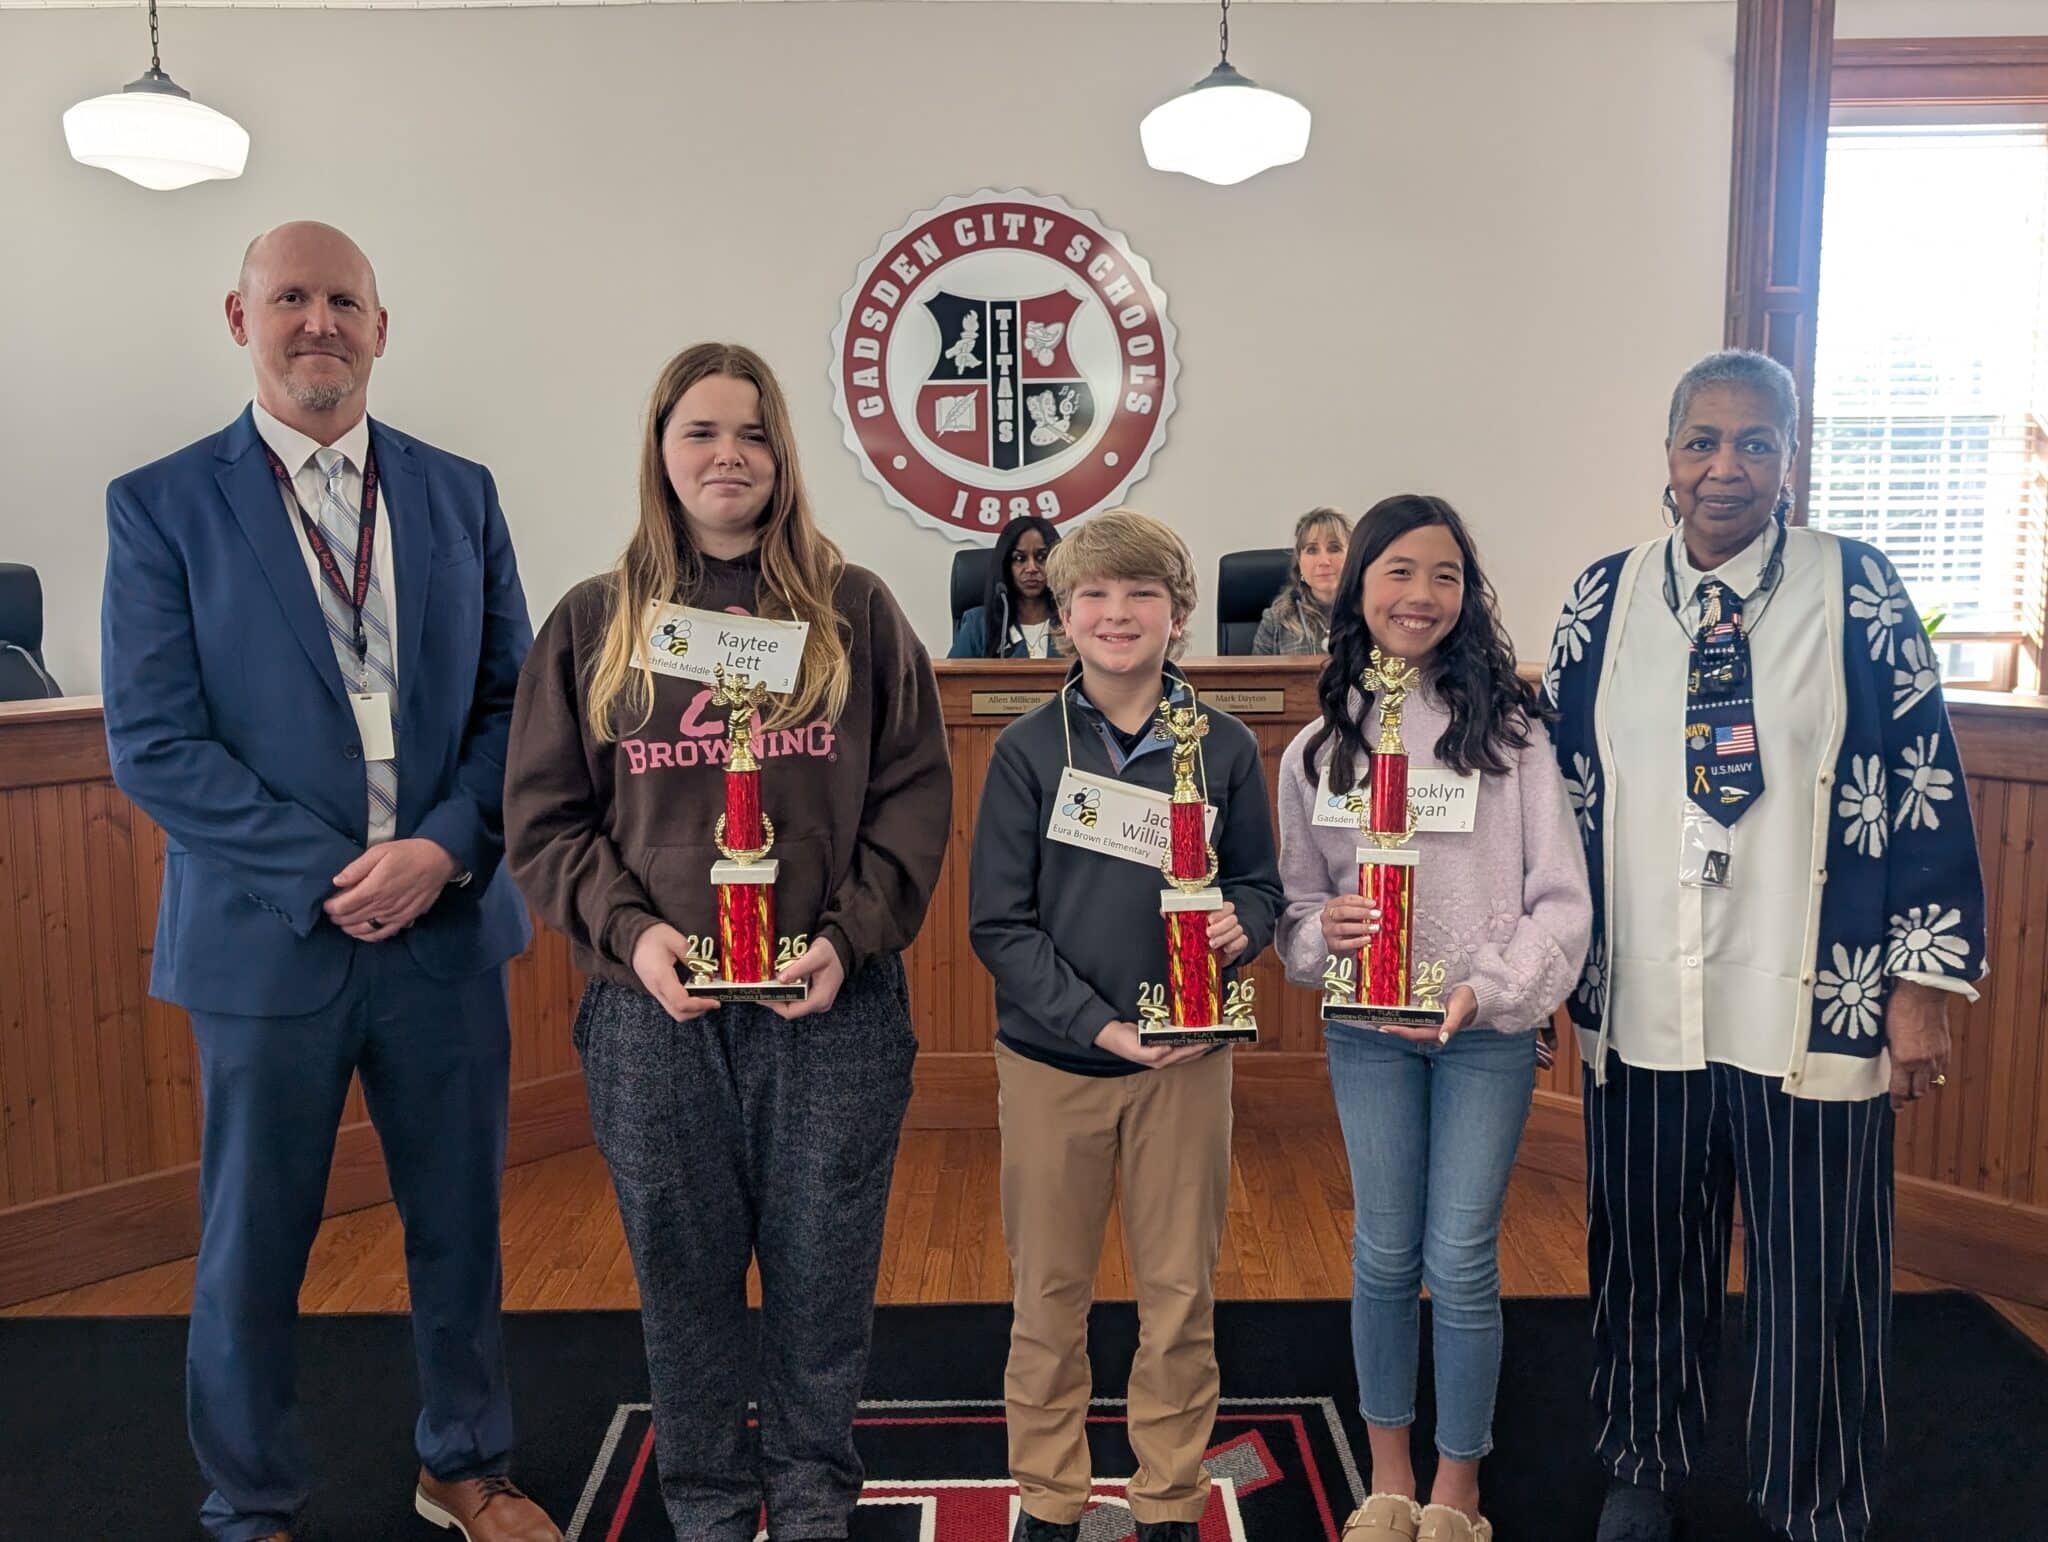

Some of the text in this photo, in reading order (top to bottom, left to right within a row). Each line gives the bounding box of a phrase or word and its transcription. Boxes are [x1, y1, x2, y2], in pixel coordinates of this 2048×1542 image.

[853, 212, 1157, 418] GADSDEN CITY SCHOOLS
[995, 308, 1014, 443] TITANS
[951, 490, 1060, 525] 1889
[717, 630, 779, 653] Kaytee
[680, 662, 711, 676] Middle
[726, 651, 762, 672] Lett
[783, 678, 789, 687] 3
[988, 695, 1008, 704] Allen
[1215, 694, 1235, 703] Mark
[1685, 723, 1710, 738] NAVY
[621, 720, 835, 775] BROWNING
[1406, 783, 1465, 802] ooklyn
[1142, 808, 1171, 829] Jac
[1317, 814, 1354, 824] Gadsden
[1460, 820, 1466, 828] 2
[1053, 823, 1150, 859] Eura Brown Elementary
[1122, 822, 1169, 849] Willia
[686, 934, 808, 960] 20 26
[1323, 954, 1446, 984] 20 26
[1137, 978, 1255, 1005] 20 26
